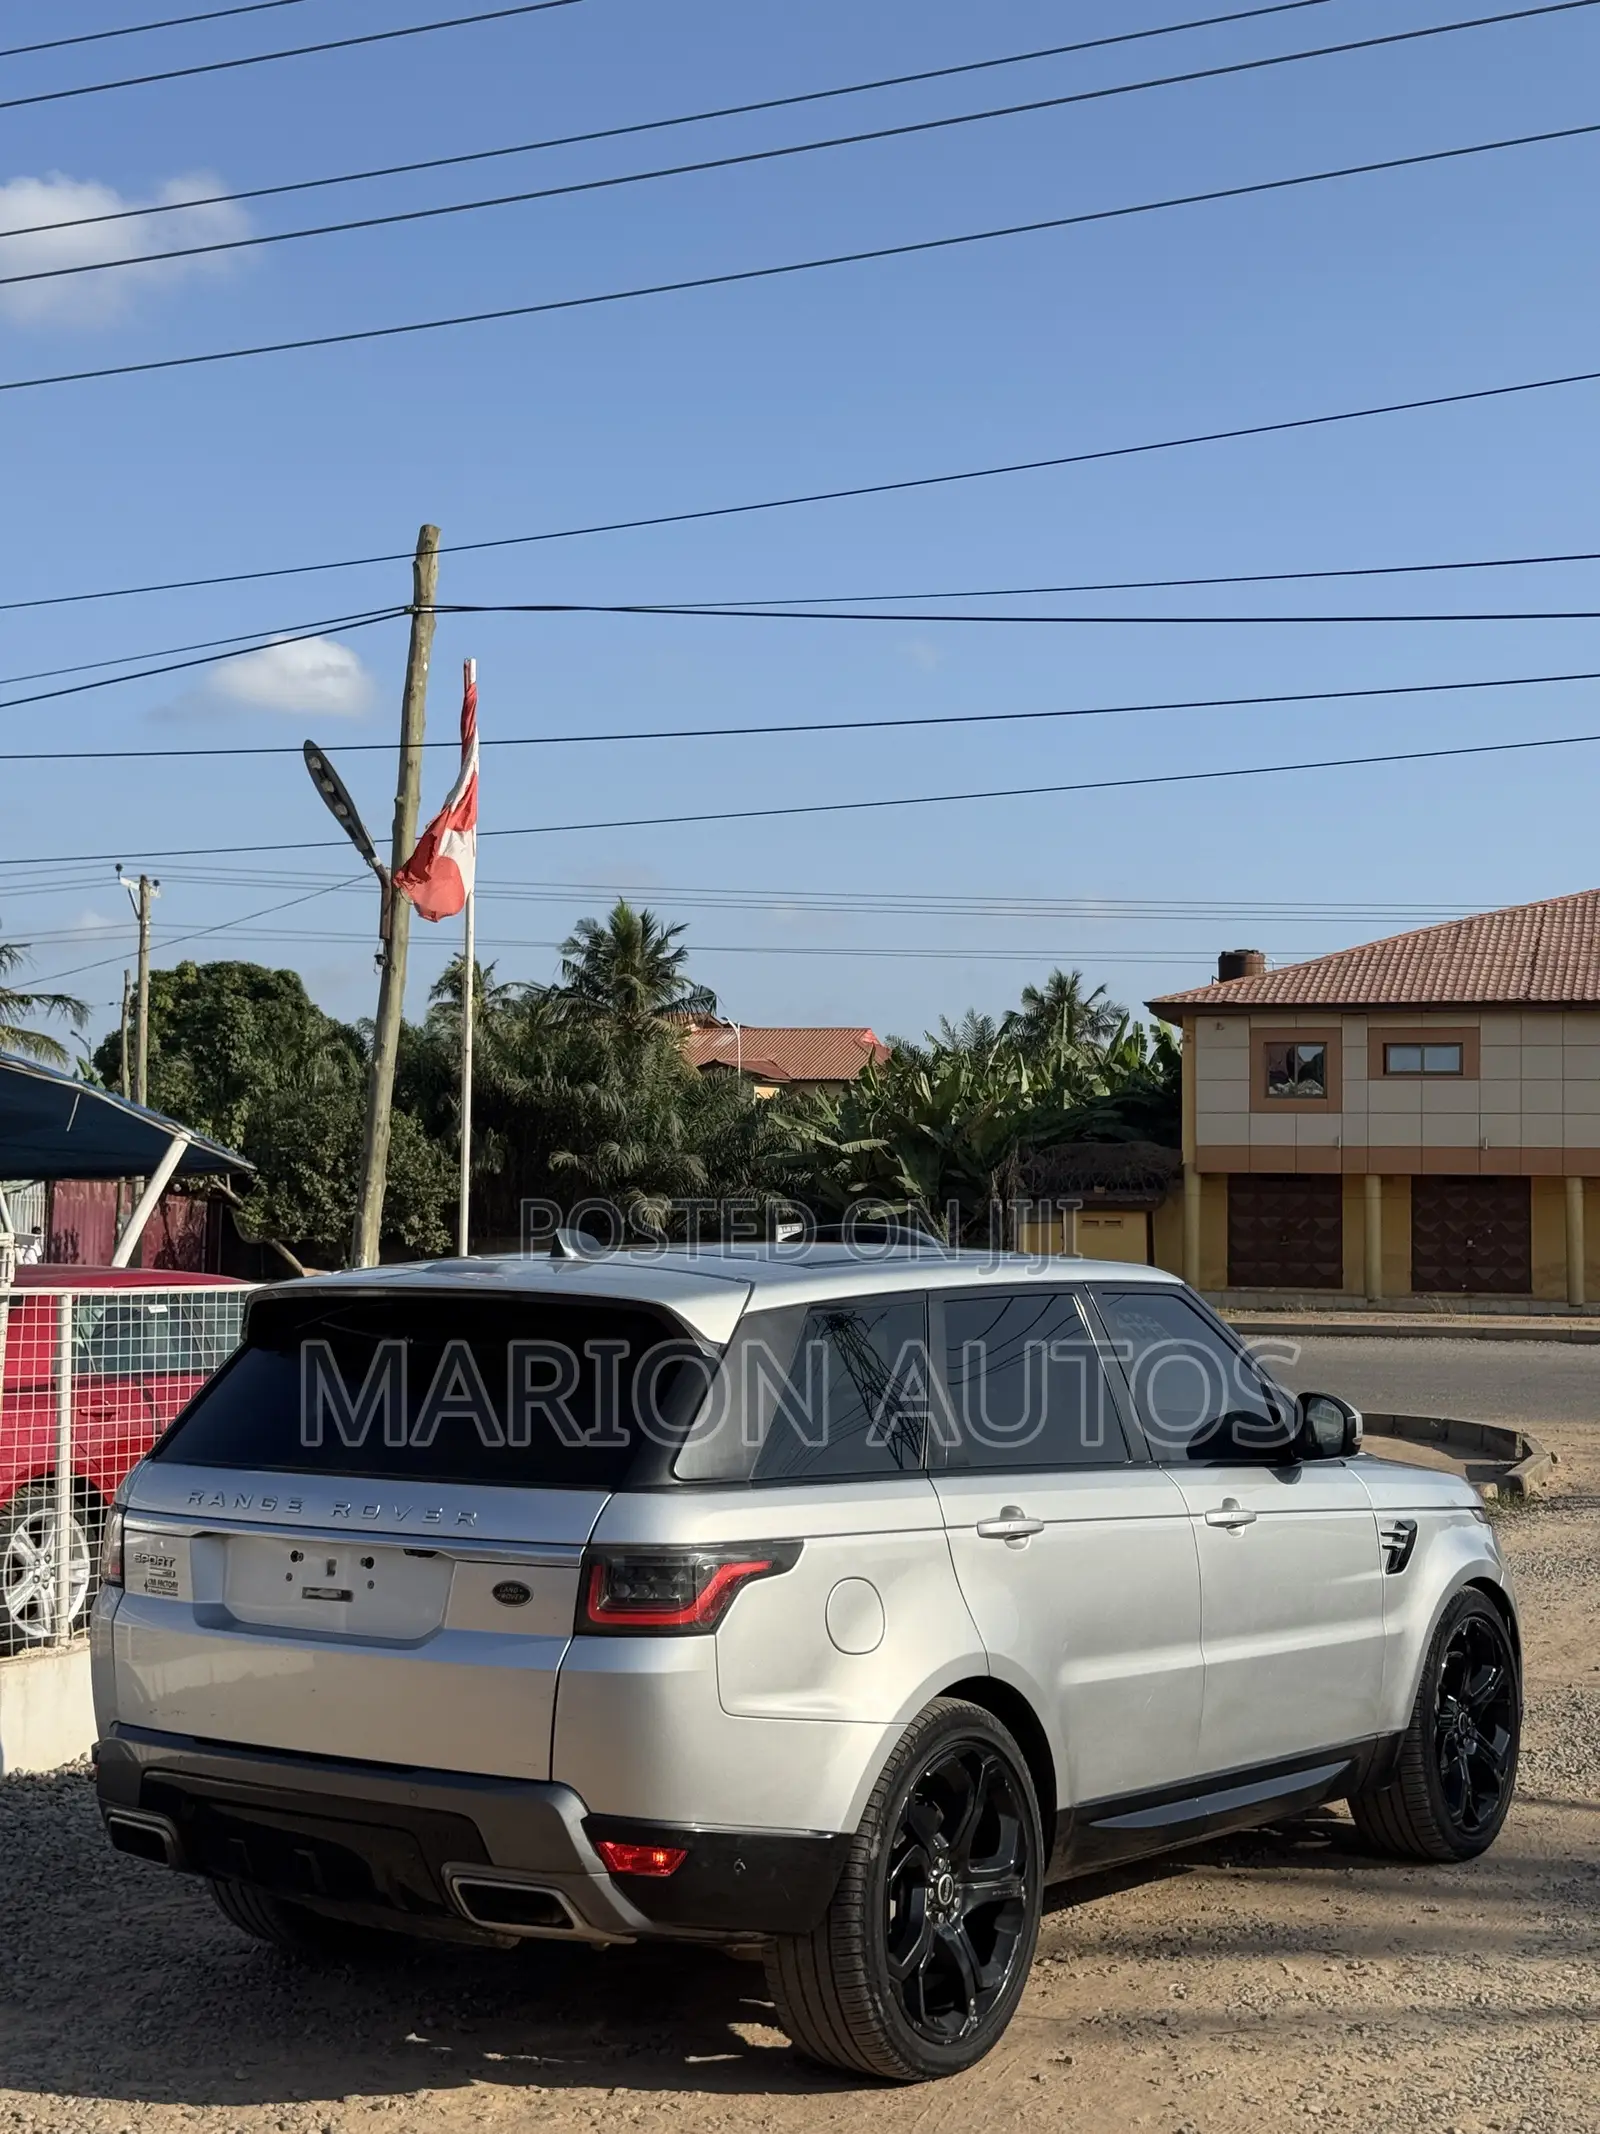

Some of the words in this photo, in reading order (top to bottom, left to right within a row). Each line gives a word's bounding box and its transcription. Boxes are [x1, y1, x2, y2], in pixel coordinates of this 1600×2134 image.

[186, 1491, 304, 1514] RANGE
[330, 1502, 477, 1528] ROVER
[132, 1552, 176, 1568] SPORT
